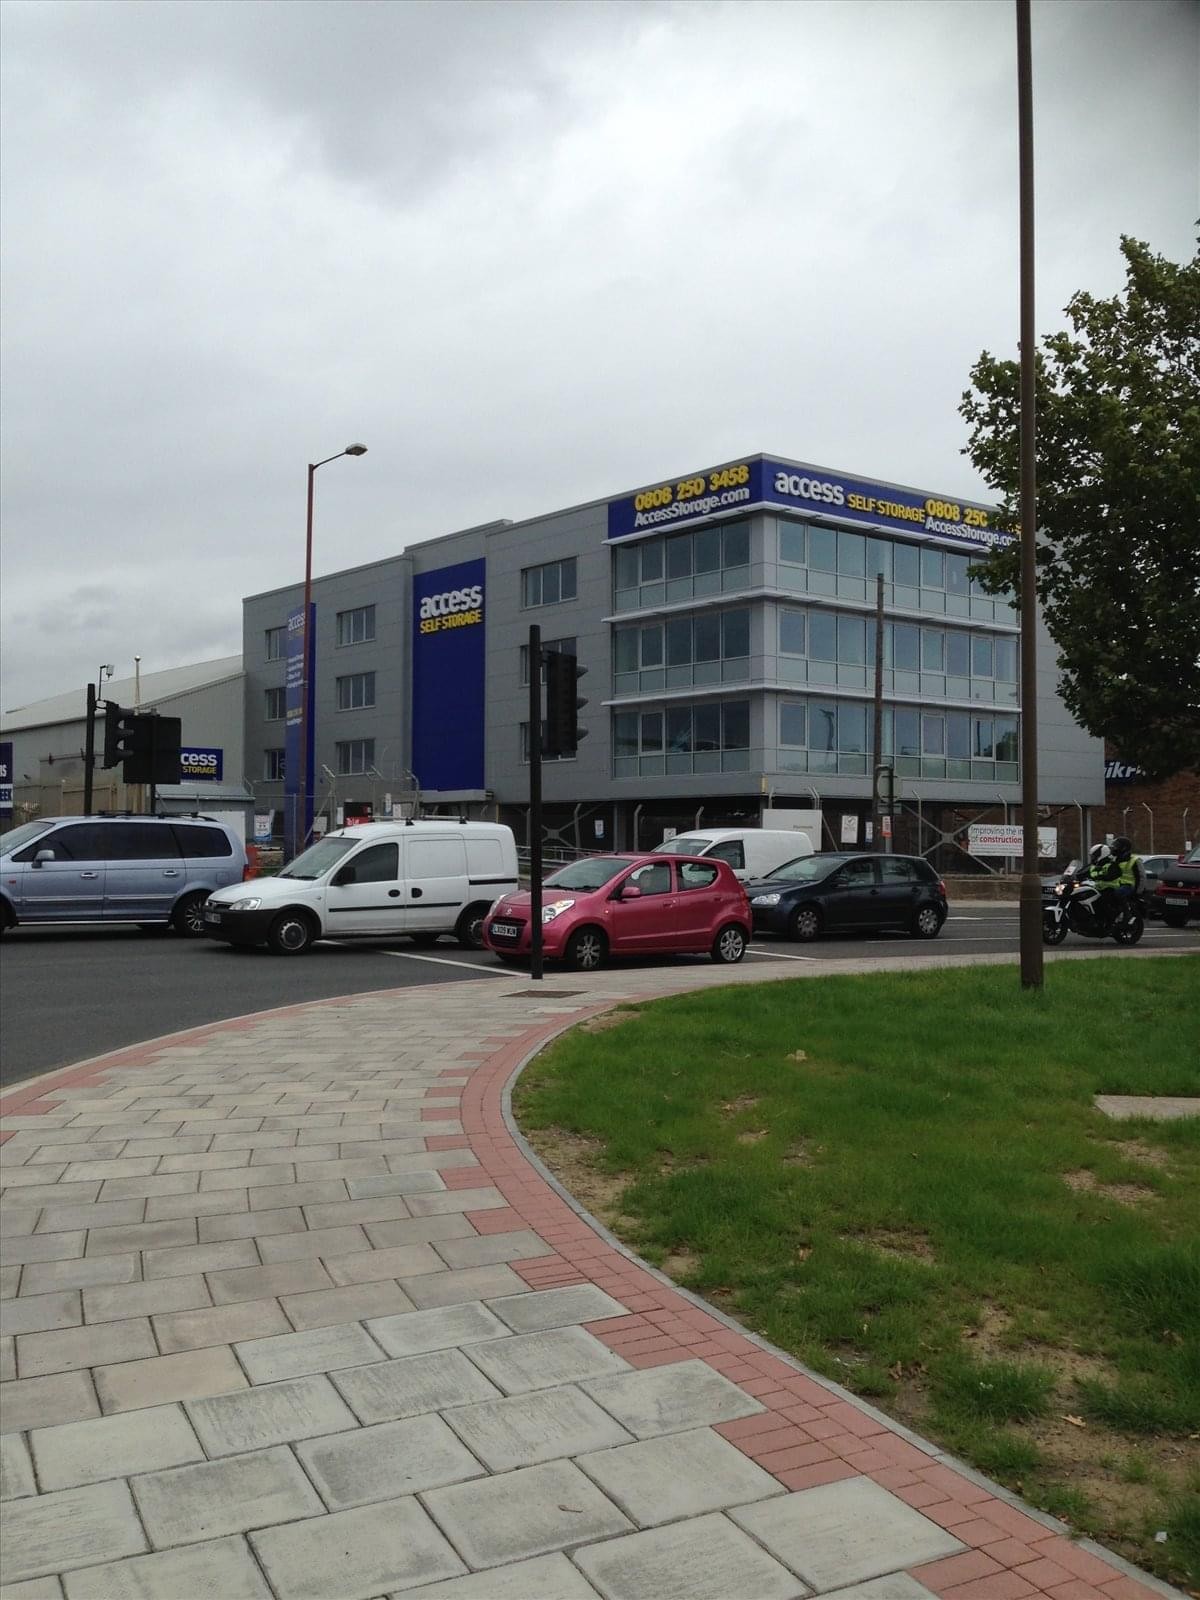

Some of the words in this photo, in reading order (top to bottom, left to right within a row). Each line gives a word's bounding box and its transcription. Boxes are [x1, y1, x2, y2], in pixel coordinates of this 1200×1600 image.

[635, 486, 673, 511] 0808
[676, 478, 706, 500] 250
[709, 465, 750, 491] 3458
[774, 471, 845, 505] access
[634, 487, 750, 527] AccessStorage.com
[847, 493, 876, 512] SELF
[877, 500, 926, 523] STORAGE
[925, 499, 960, 521] 0808
[420, 585, 483, 619] access
[420, 617, 442, 634] SELF
[441, 609, 483, 629] STORAGE
[182, 765, 217, 774] STORAGE
[979, 836, 1022, 844] construction
[1006, 823, 1017, 834] the
